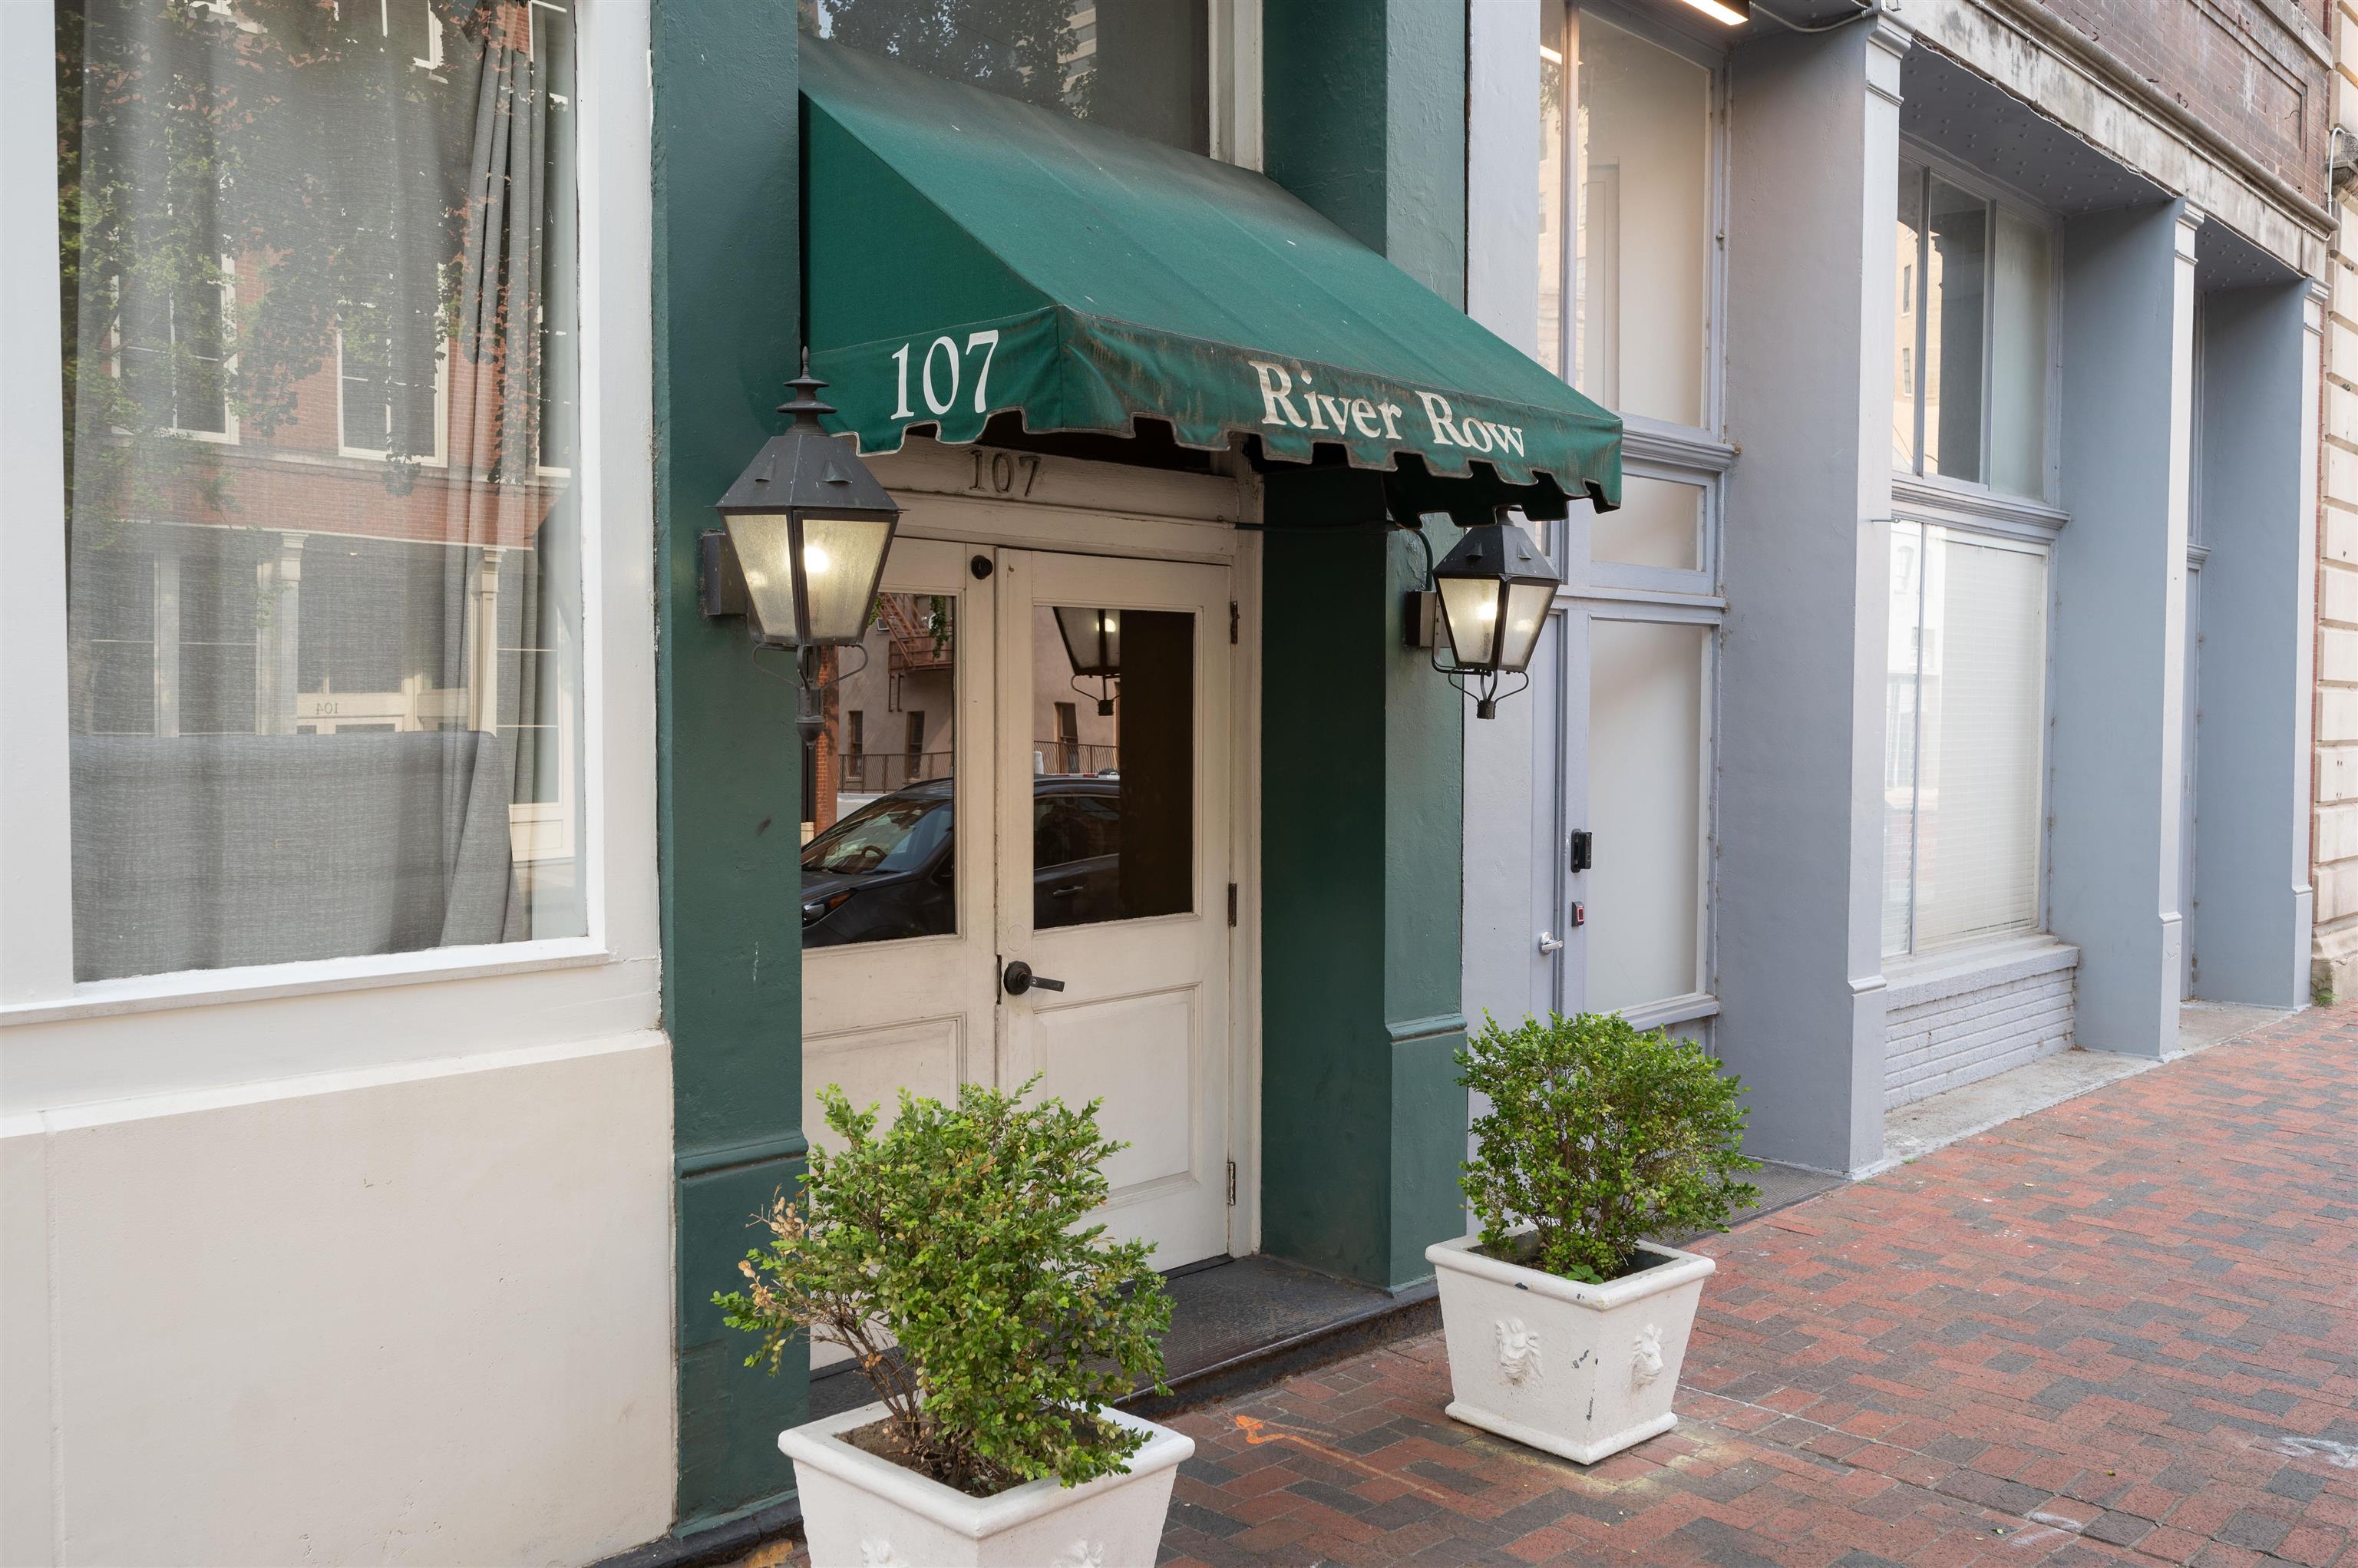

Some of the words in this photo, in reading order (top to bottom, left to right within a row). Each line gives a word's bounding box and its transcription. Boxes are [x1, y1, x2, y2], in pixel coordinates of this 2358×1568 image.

[890, 329, 999, 420] 107
[1248, 360, 1402, 441] River
[1415, 391, 1524, 457] Row
[969, 449, 1042, 497] 107
